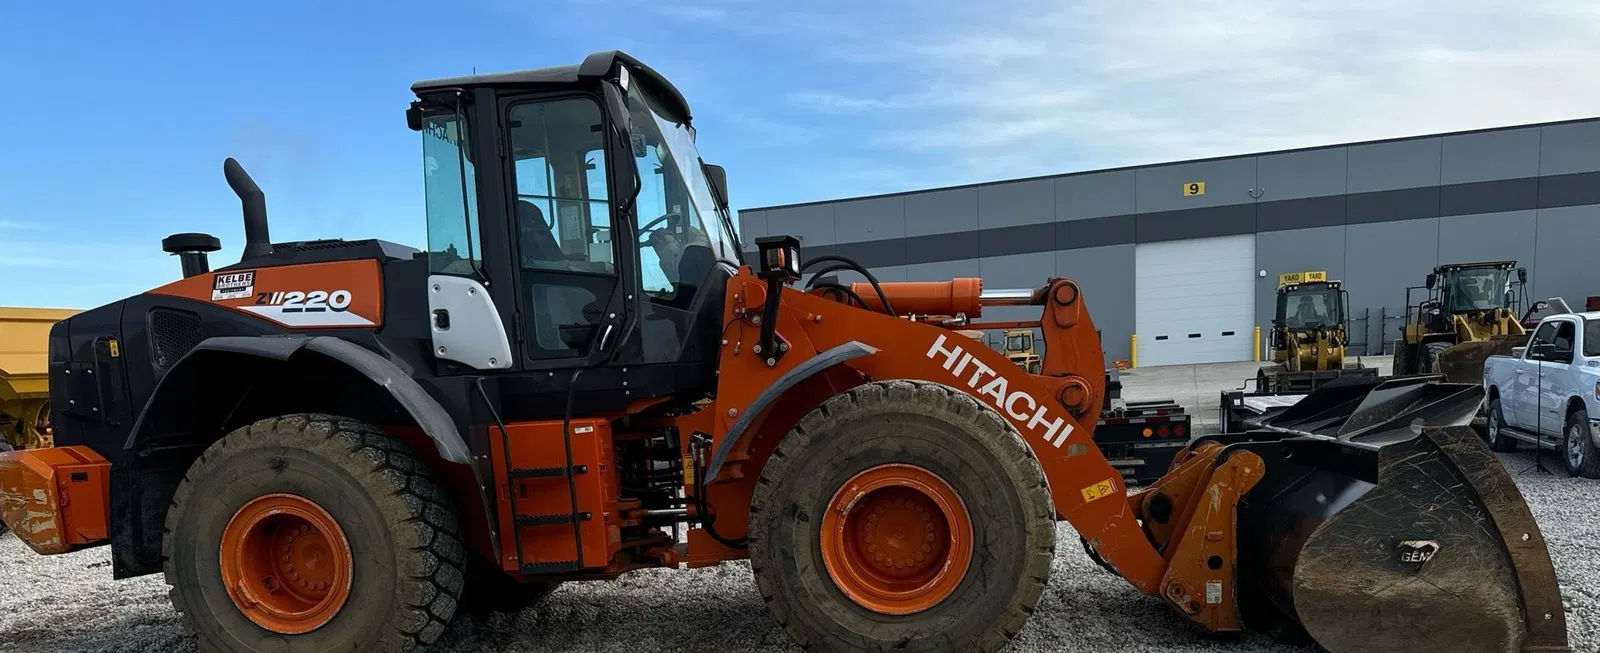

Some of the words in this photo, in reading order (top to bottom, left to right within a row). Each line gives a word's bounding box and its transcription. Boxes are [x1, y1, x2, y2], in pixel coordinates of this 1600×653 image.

[1189, 183, 1199, 195] 9
[218, 273, 252, 284] KELBE
[1308, 272, 1323, 280] YARD
[926, 333, 1075, 449] HITACHI
[1401, 551, 1431, 562] GEM
